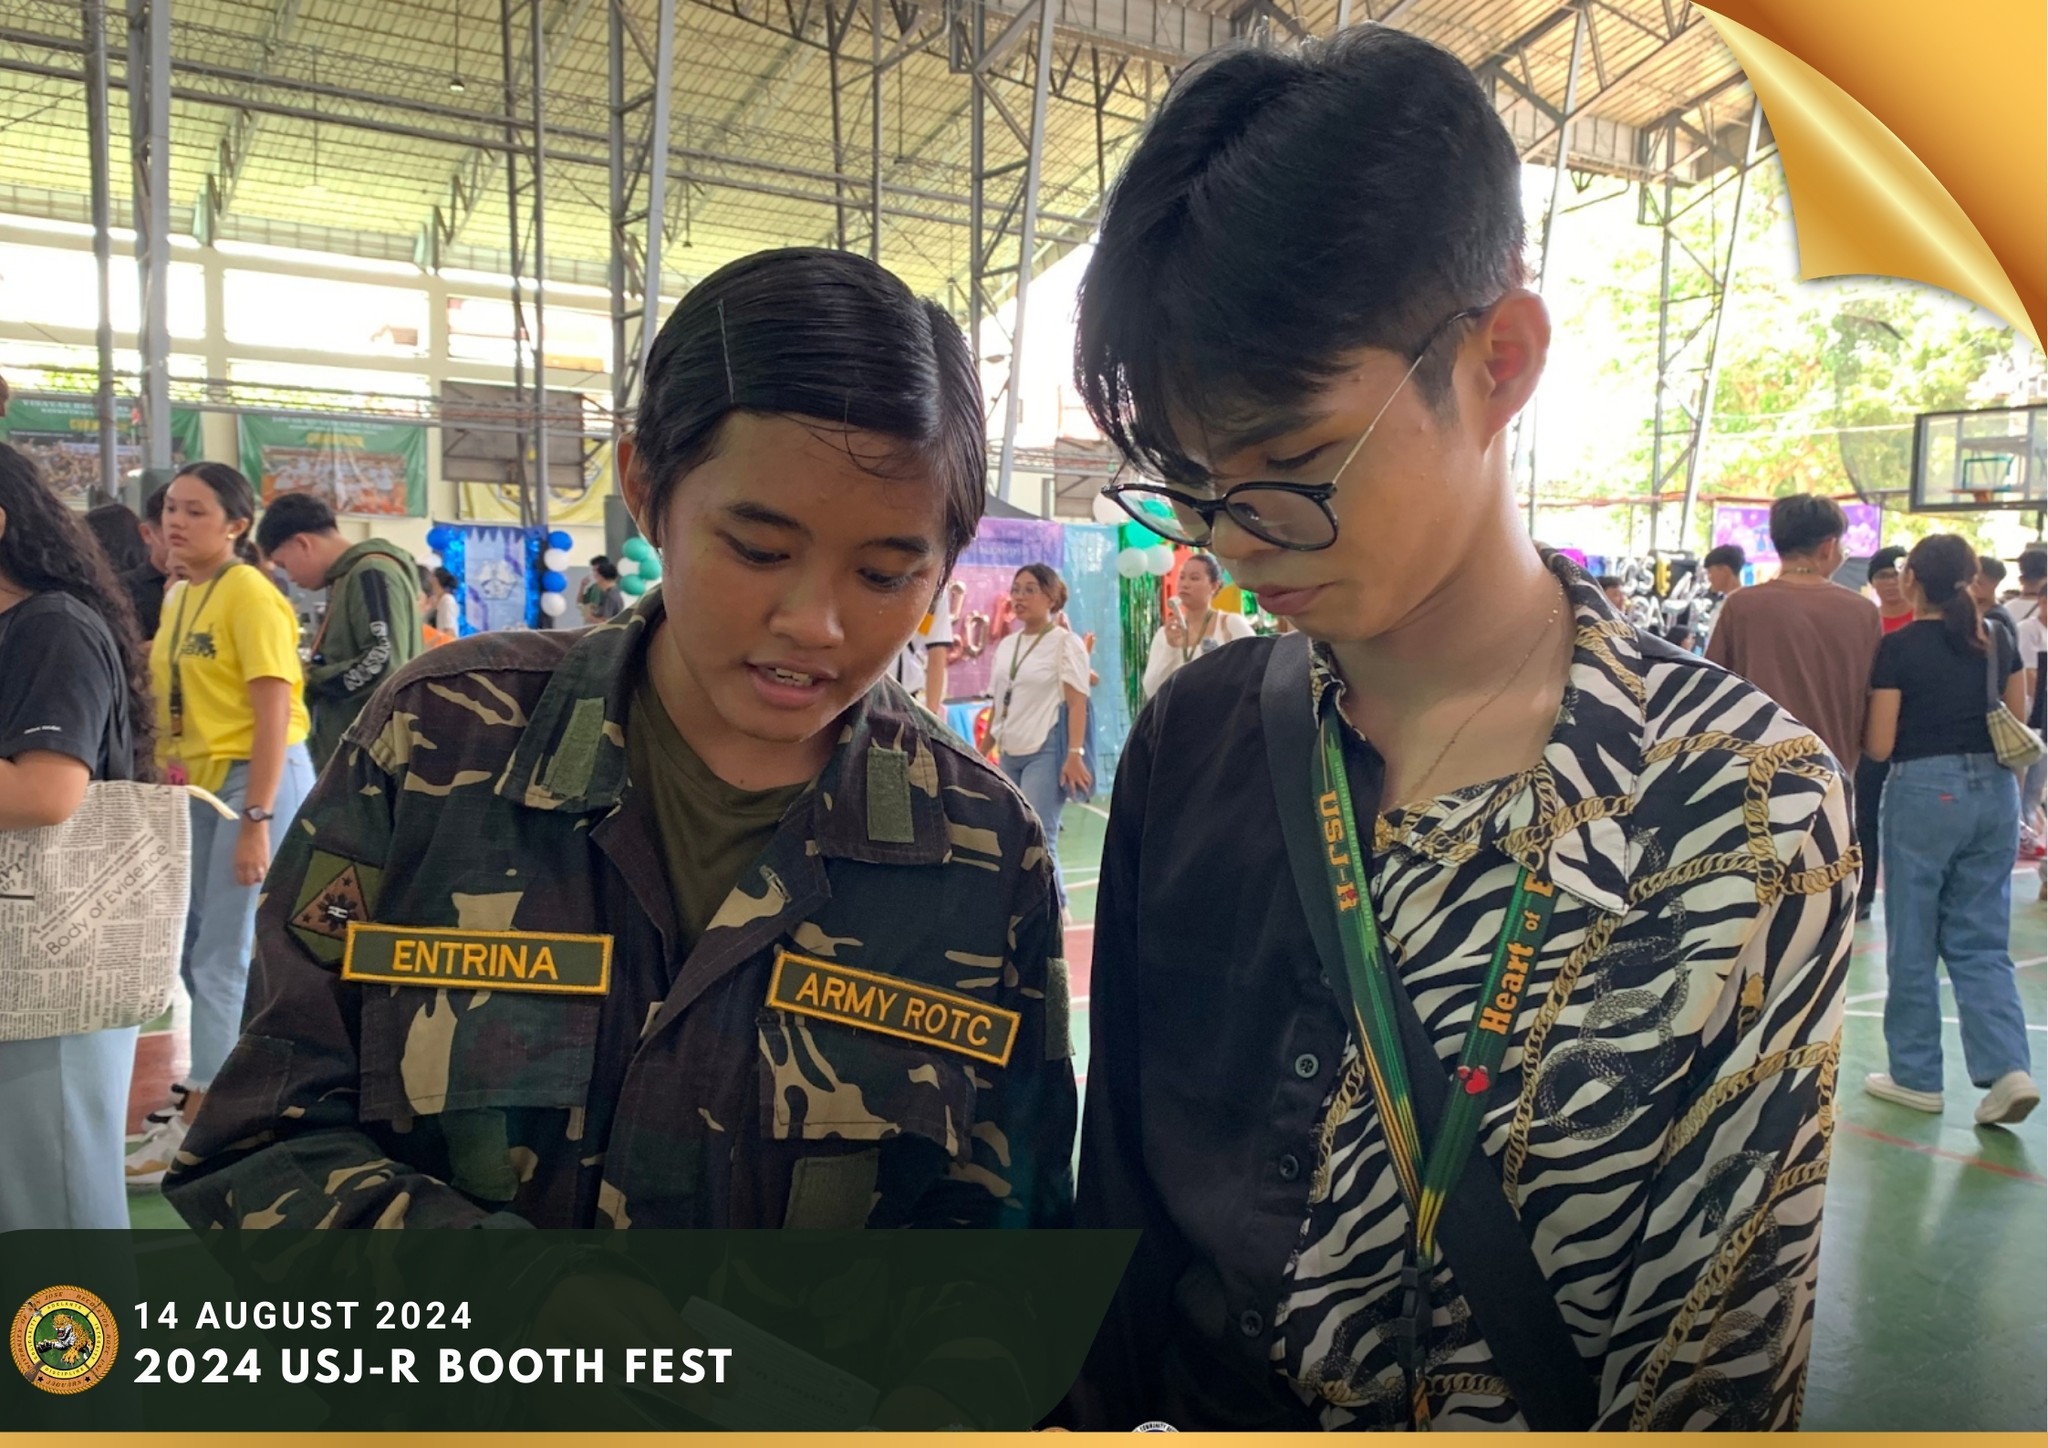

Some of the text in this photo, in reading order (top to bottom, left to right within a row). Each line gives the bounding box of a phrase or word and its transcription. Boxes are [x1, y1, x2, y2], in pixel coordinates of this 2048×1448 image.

[46, 919, 88, 957] Body
[88, 898, 107, 918] of
[105, 843, 168, 905] Evidence
[392, 939, 559, 981] ENTRINA
[1479, 943, 1535, 1034] Heart
[1524, 910, 1541, 931] of
[795, 972, 992, 1047] ARMY ROTC
